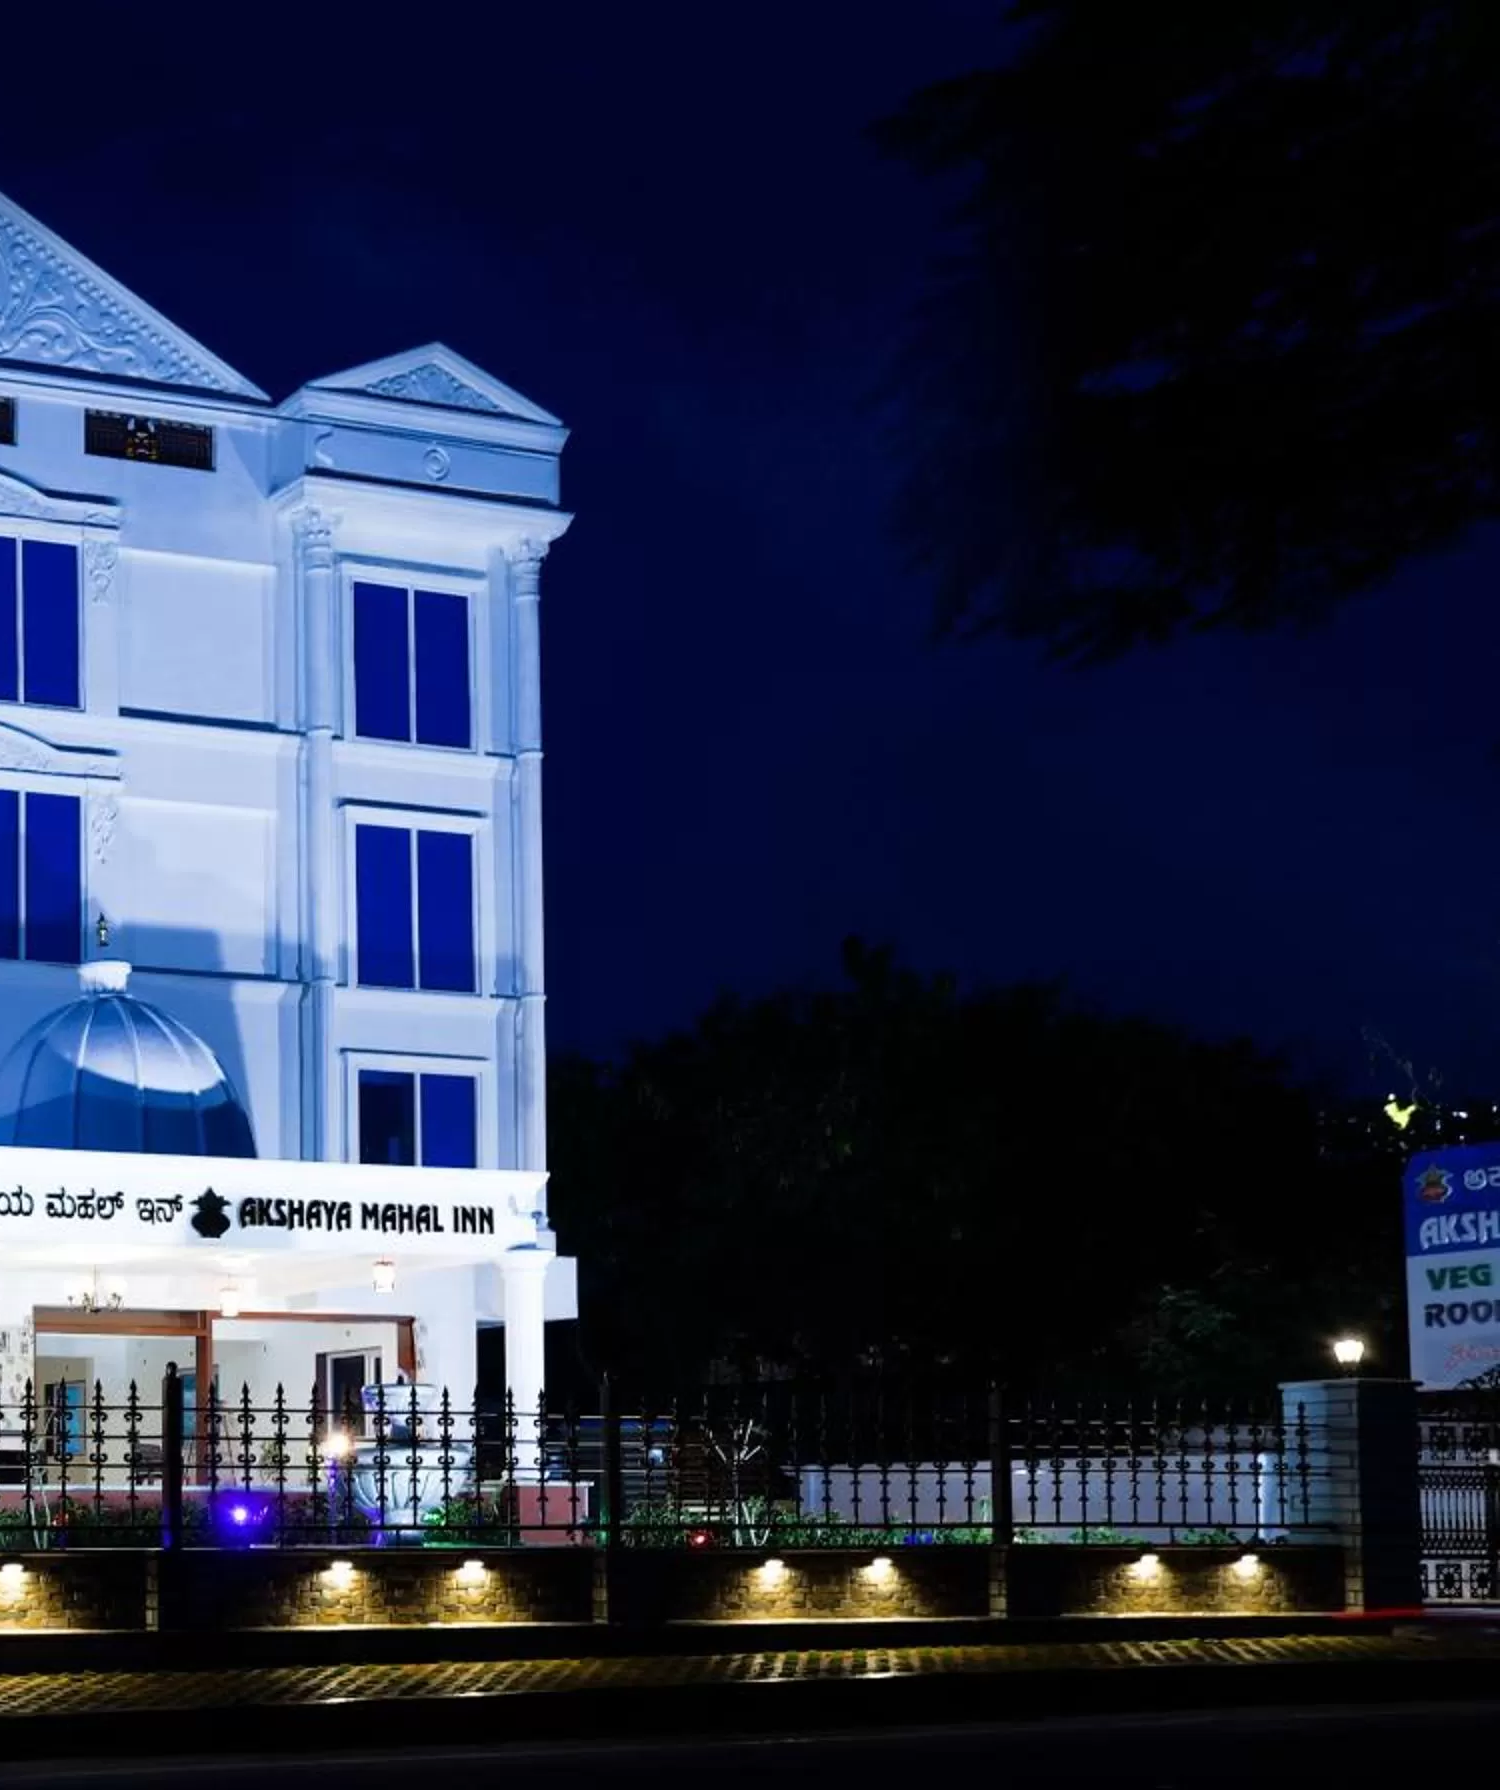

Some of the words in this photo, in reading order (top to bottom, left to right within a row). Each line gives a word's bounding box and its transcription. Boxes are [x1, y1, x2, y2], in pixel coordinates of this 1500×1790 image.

[45, 1186, 125, 1220] ಮಹಲ್
[135, 1193, 184, 1225] ಇನ್
[238, 1196, 352, 1232] AKSHAYA
[360, 1202, 445, 1235] MAHAL
[453, 1205, 495, 1235] INN
[1425, 1263, 1492, 1291] VEG
[1423, 1299, 1500, 1328] ROO
